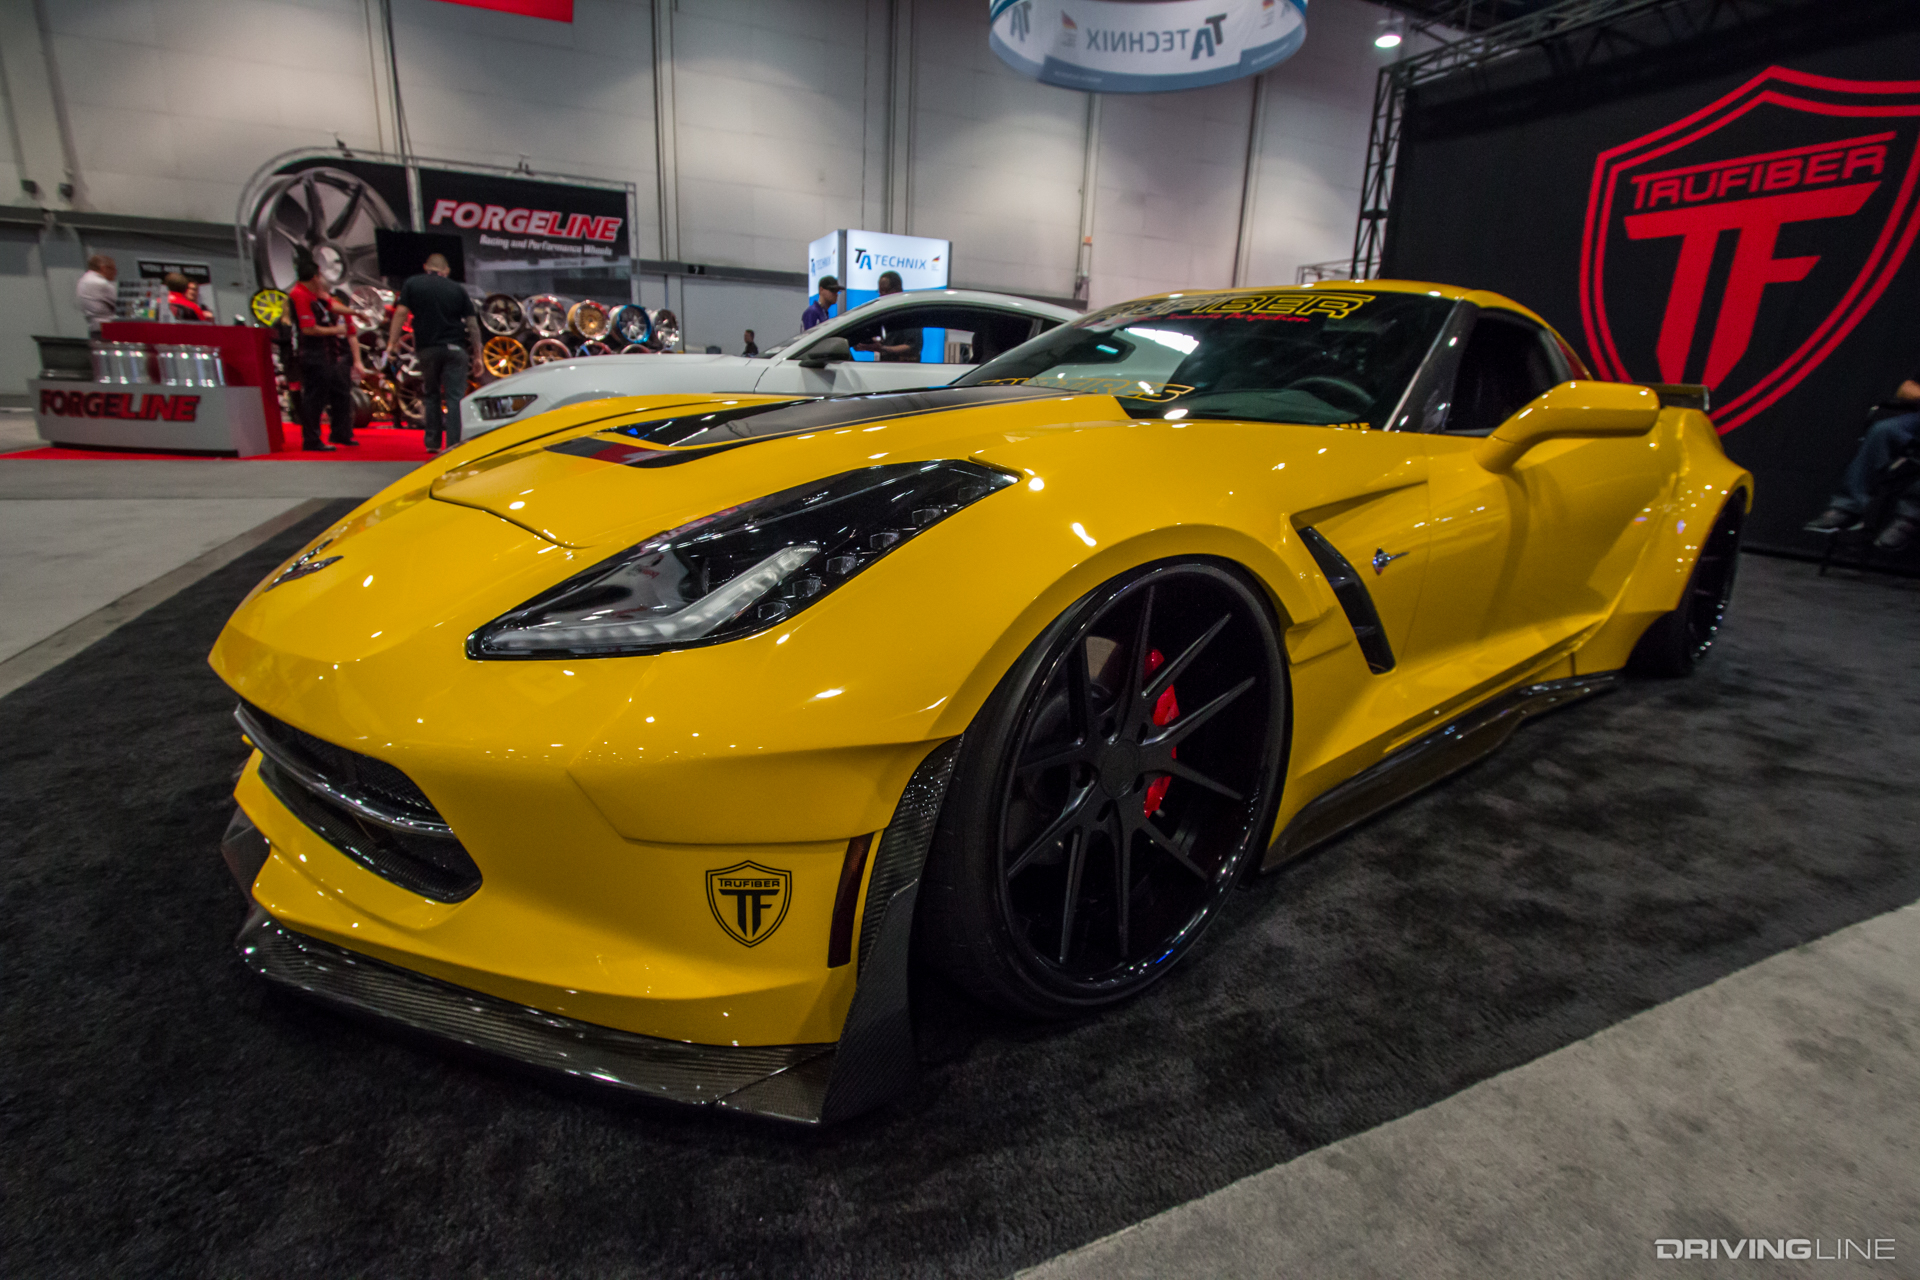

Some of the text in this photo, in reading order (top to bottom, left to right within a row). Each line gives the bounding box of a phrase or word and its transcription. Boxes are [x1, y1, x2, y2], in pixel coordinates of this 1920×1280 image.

[1630, 131, 1897, 210] TRUFIBER
[430, 199, 623, 242] FORGELINE
[479, 234, 509, 250] Racing
[510, 239, 527, 249] and
[528, 239, 582, 253] Performance
[855, 248, 872, 270] TA
[874, 254, 927, 270] TECHNIX
[1623, 181, 1882, 392] TF
[39, 388, 201, 422] FORGELINE
[717, 878, 780, 888] TRUFIBER
[718, 888, 780, 937] TF
